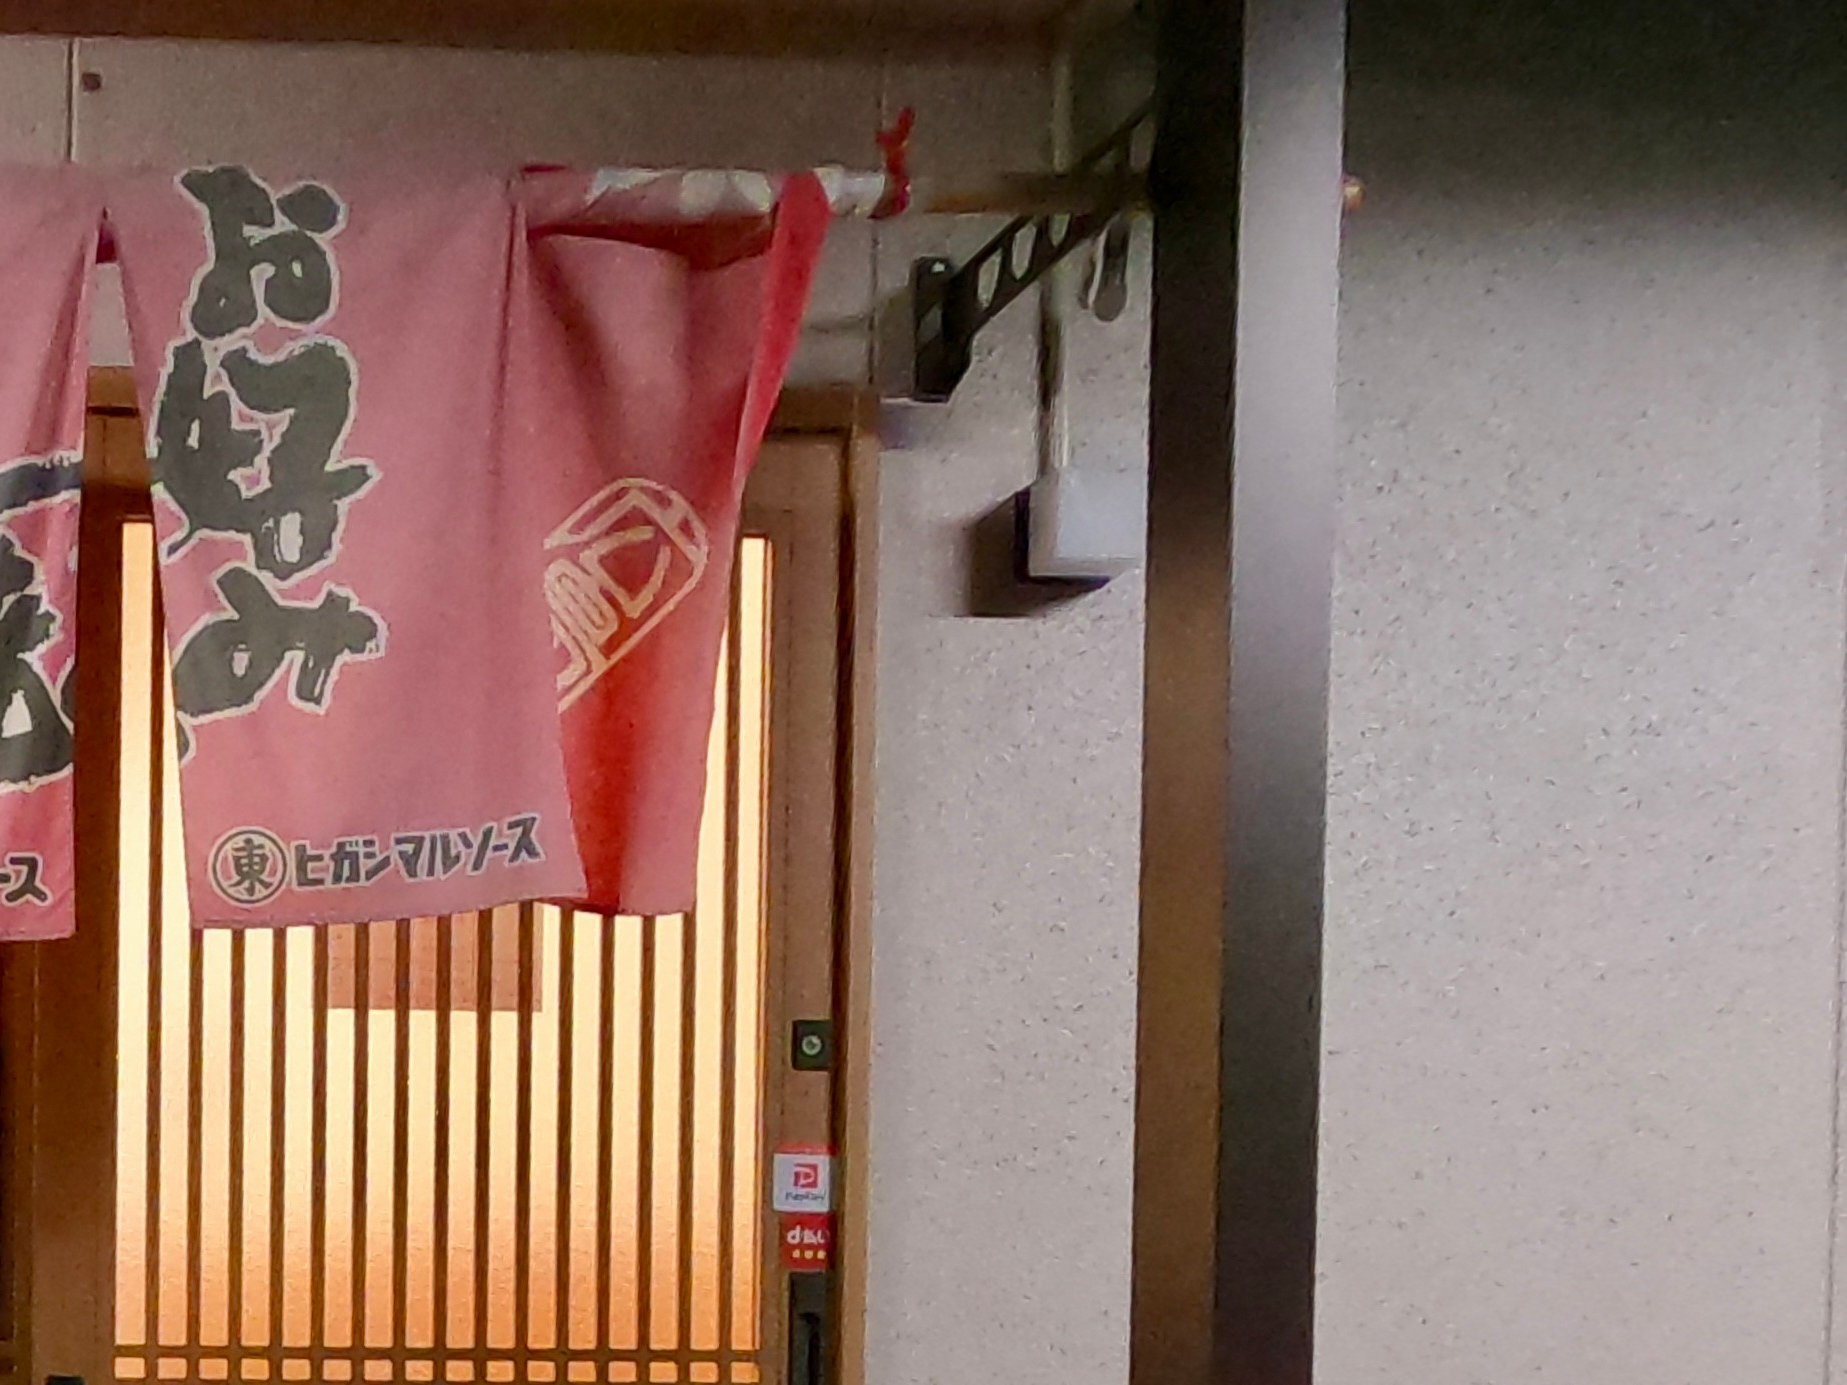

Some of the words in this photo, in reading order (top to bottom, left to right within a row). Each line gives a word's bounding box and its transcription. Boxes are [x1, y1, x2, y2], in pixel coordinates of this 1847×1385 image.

[149, 164, 384, 716] お好み
[293, 814, 542, 888] ヒガシマルソース
